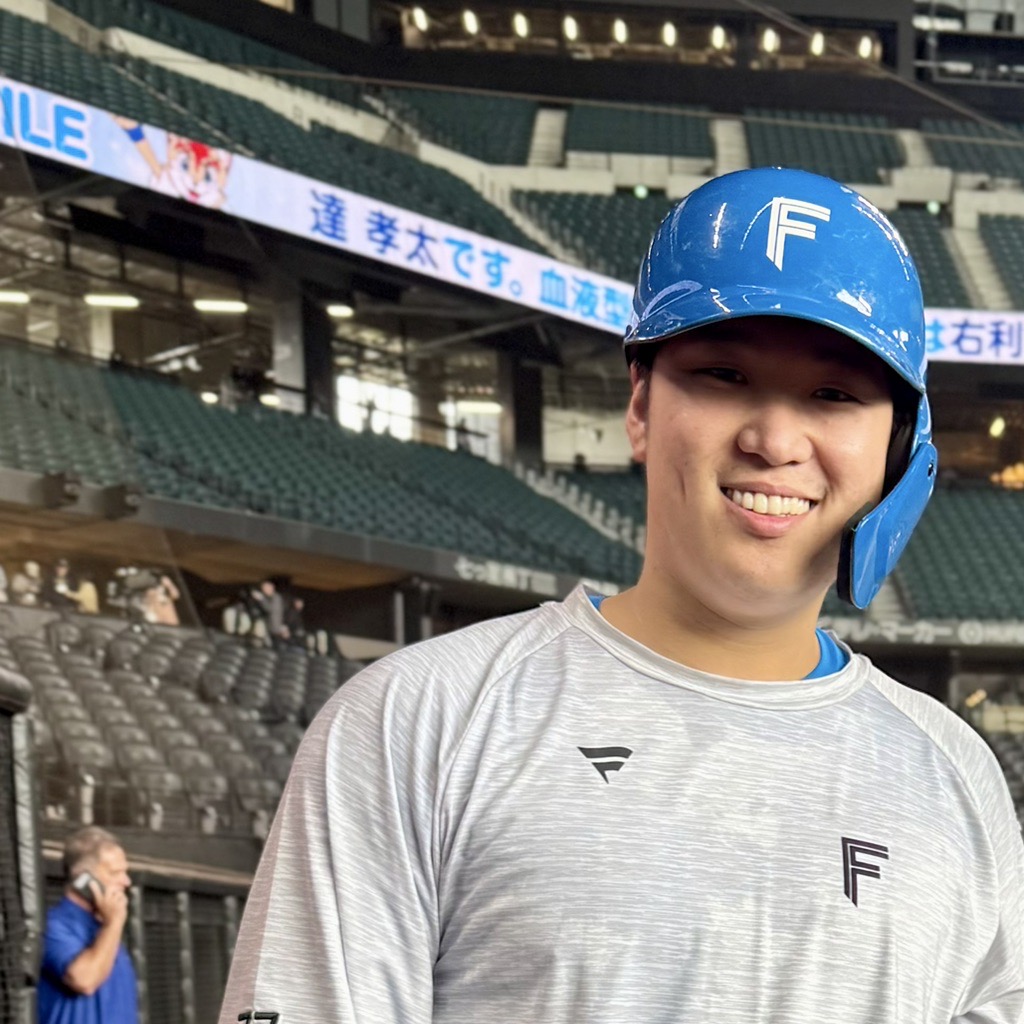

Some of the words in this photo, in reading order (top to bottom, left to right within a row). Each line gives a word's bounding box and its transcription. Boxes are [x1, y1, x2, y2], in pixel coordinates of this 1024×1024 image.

[310, 189, 347, 242] 達
[765, 196, 832, 272] F
[841, 836, 889, 908] F
